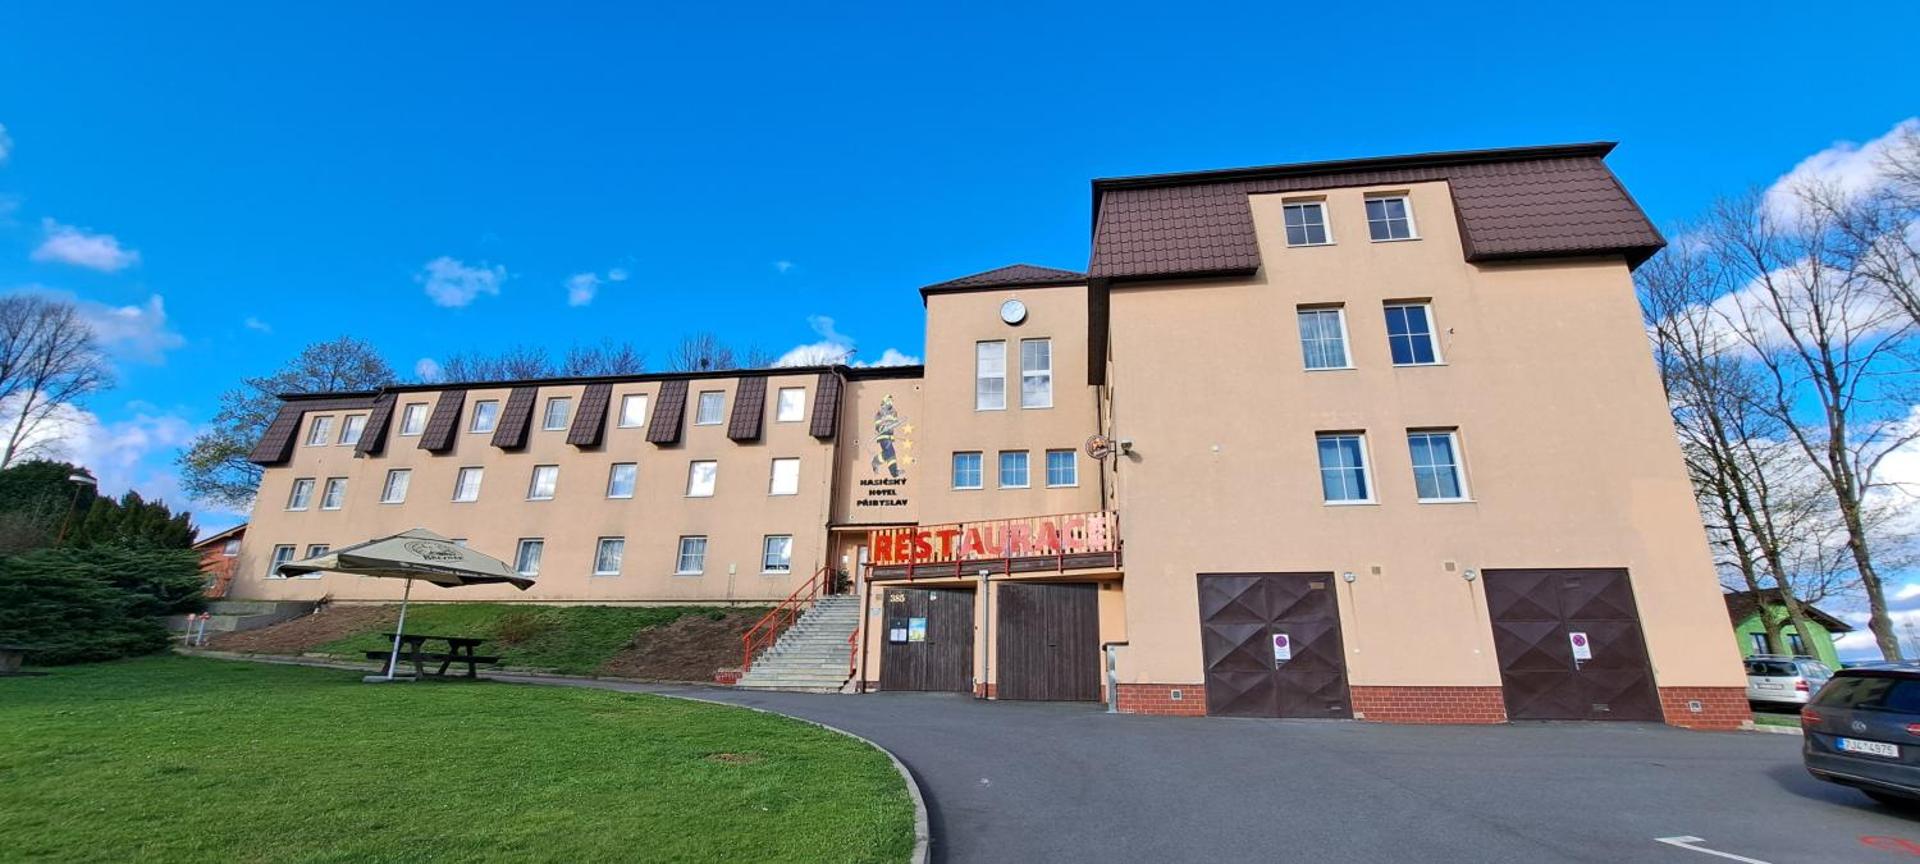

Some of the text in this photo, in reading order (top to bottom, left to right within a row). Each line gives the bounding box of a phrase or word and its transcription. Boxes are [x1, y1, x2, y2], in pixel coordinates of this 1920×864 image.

[860, 477, 907, 486] HASIČSKÝ
[874, 516, 1105, 562] RESTAURACE
[890, 594, 906, 602] 385
